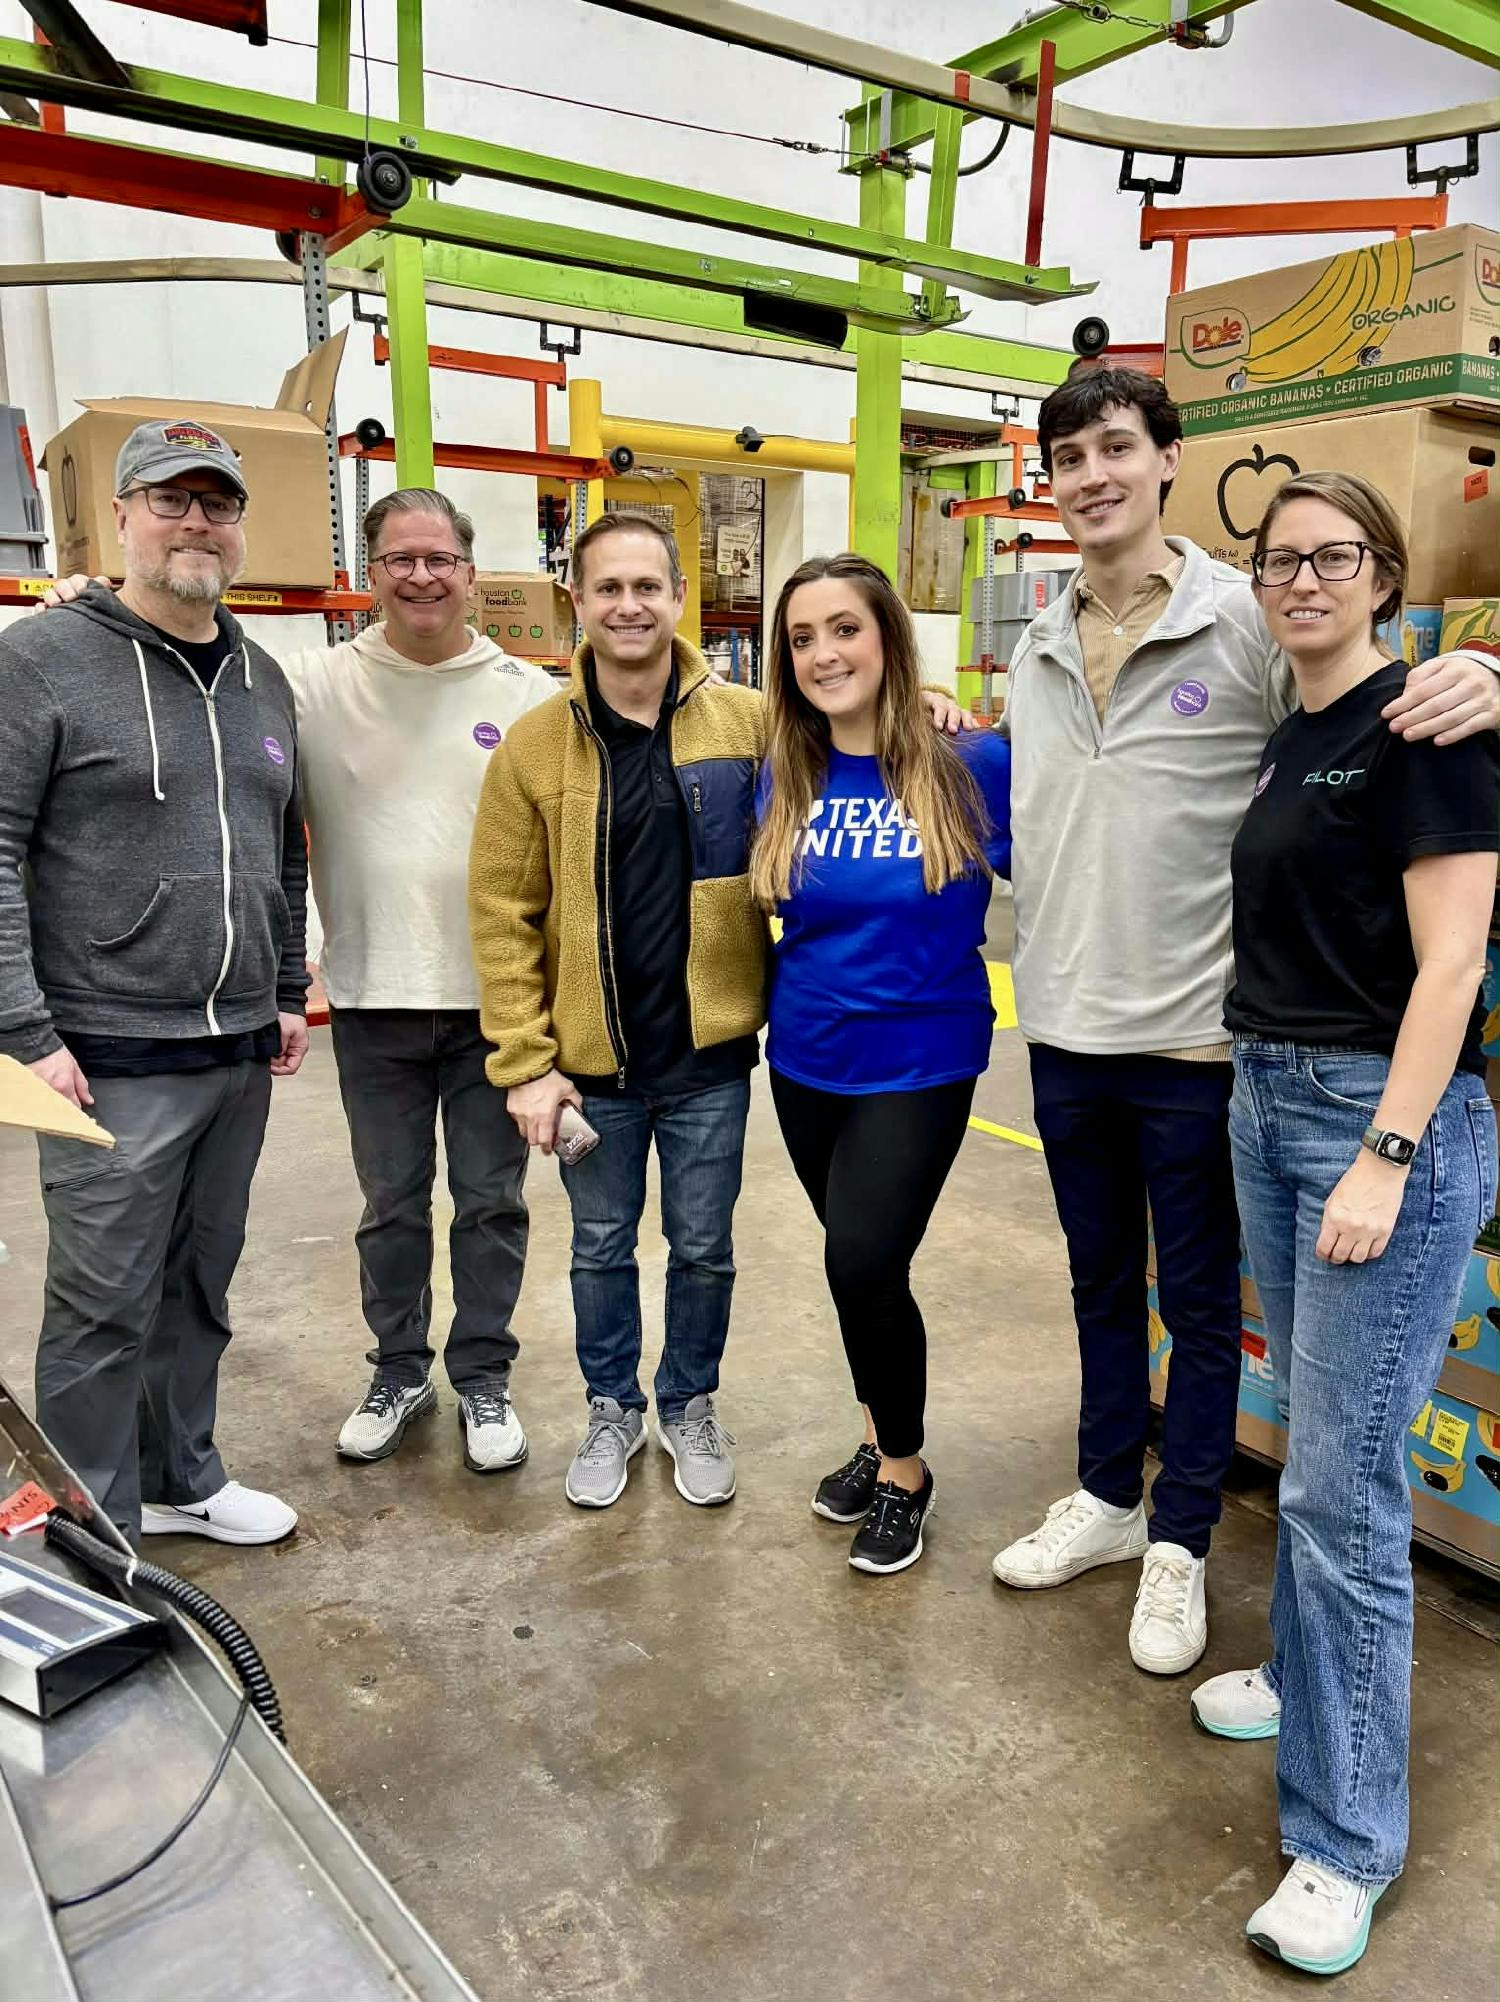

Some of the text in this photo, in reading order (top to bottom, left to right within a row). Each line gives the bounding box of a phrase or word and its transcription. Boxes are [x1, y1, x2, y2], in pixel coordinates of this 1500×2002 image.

[1352, 295, 1456, 331] ORGANIC
[1192, 316, 1242, 348] Dole
[1462, 359, 1496, 380] BANANAS
[1178, 404, 1218, 423] ERTIFIED
[1221, 394, 1267, 415] ORGANIC
[1270, 384, 1324, 406] BANANAS
[1334, 371, 1393, 395] CERTIFIED
[1396, 360, 1454, 384] ORGANIC
[480, 586, 510, 597] houston
[485, 597, 527, 606] foodbank
